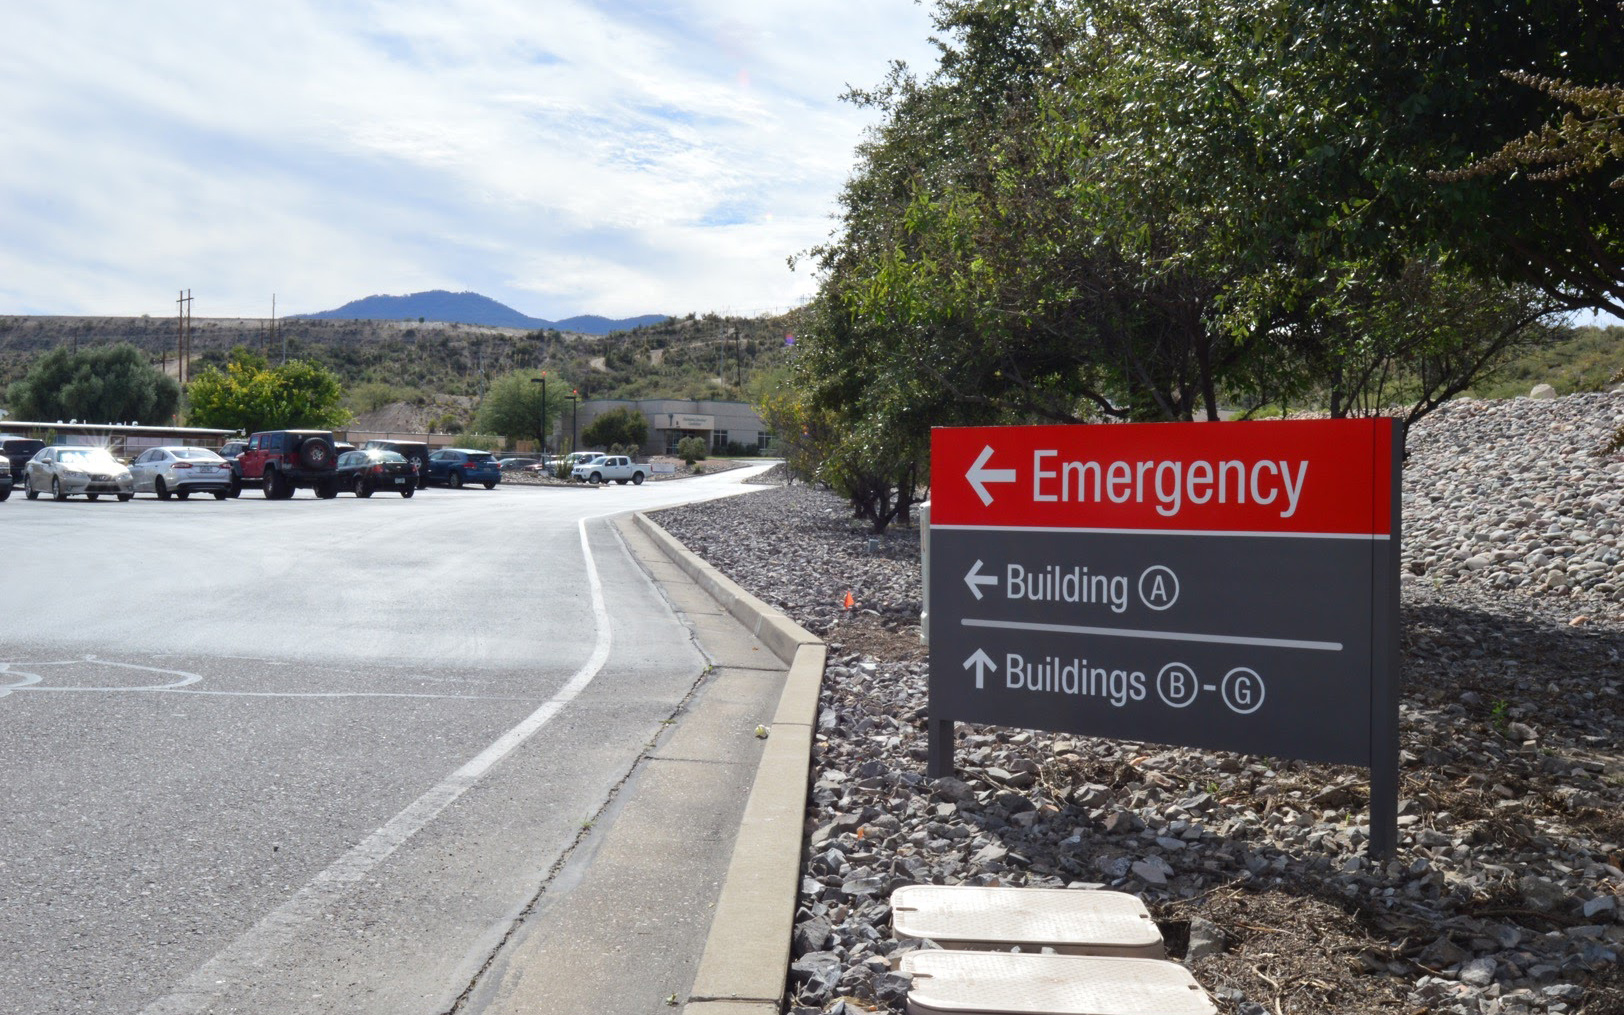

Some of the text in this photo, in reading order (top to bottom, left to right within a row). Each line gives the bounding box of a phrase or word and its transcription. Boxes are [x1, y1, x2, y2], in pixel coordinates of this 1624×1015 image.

[1032, 448, 1310, 519] Emergency
[1007, 563, 1129, 615] Building
[1005, 653, 1148, 708] Buildings
